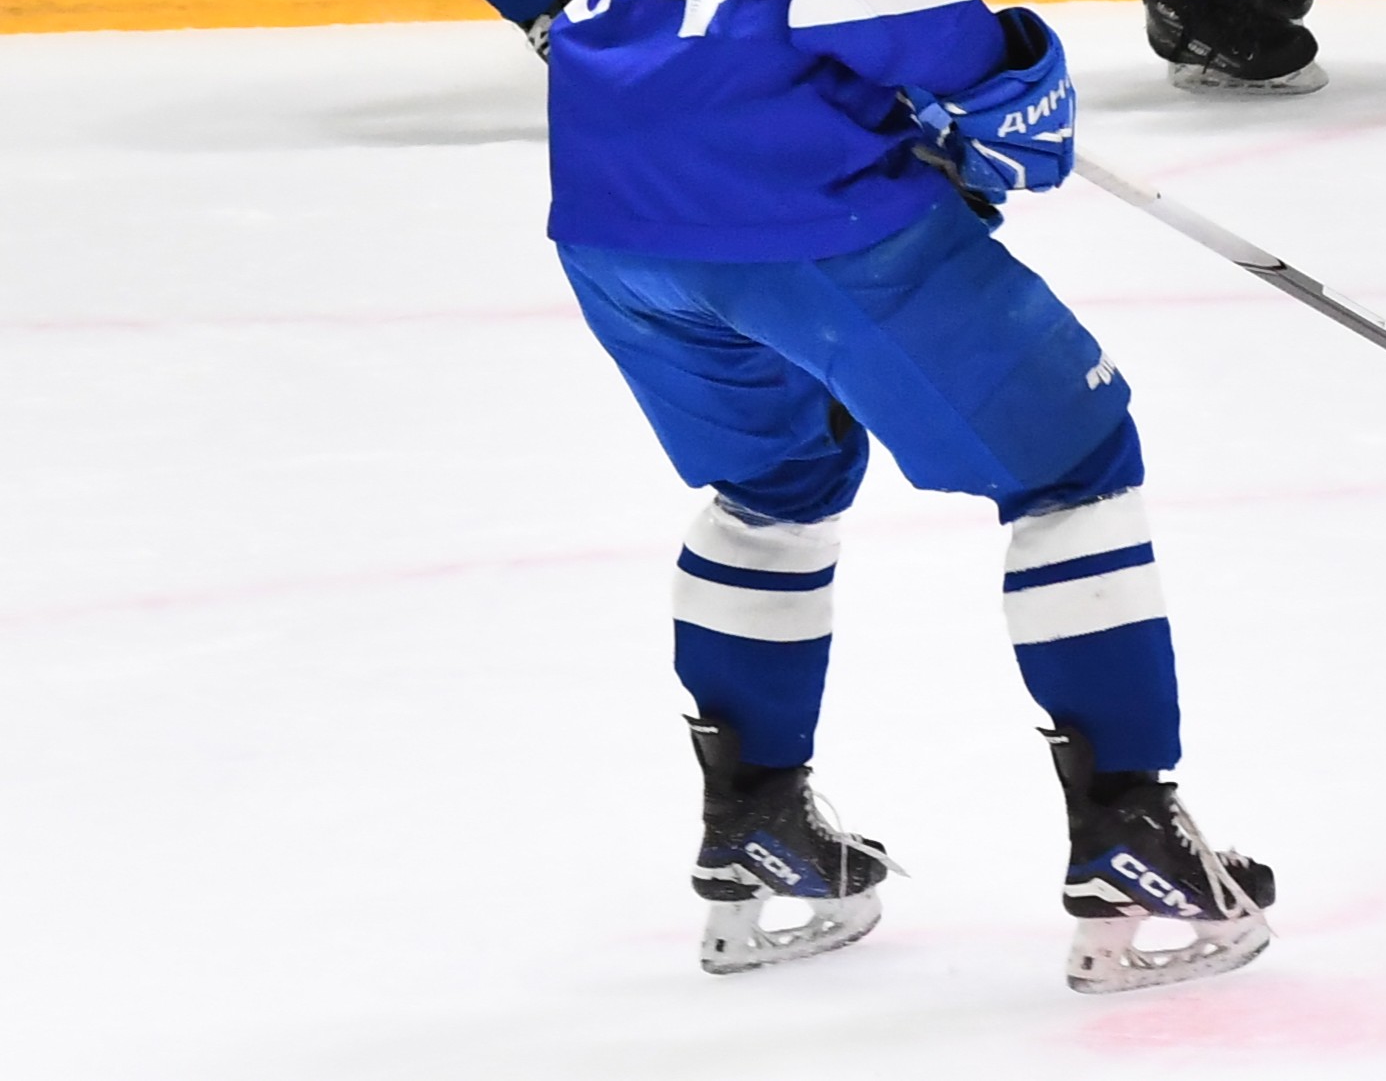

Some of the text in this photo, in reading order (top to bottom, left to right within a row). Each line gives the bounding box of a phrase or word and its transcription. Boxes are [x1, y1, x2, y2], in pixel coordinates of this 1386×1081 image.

[998, 77, 1070, 138] ДИН
[744, 841, 802, 887] CCM
[1110, 851, 1204, 917] CCM
